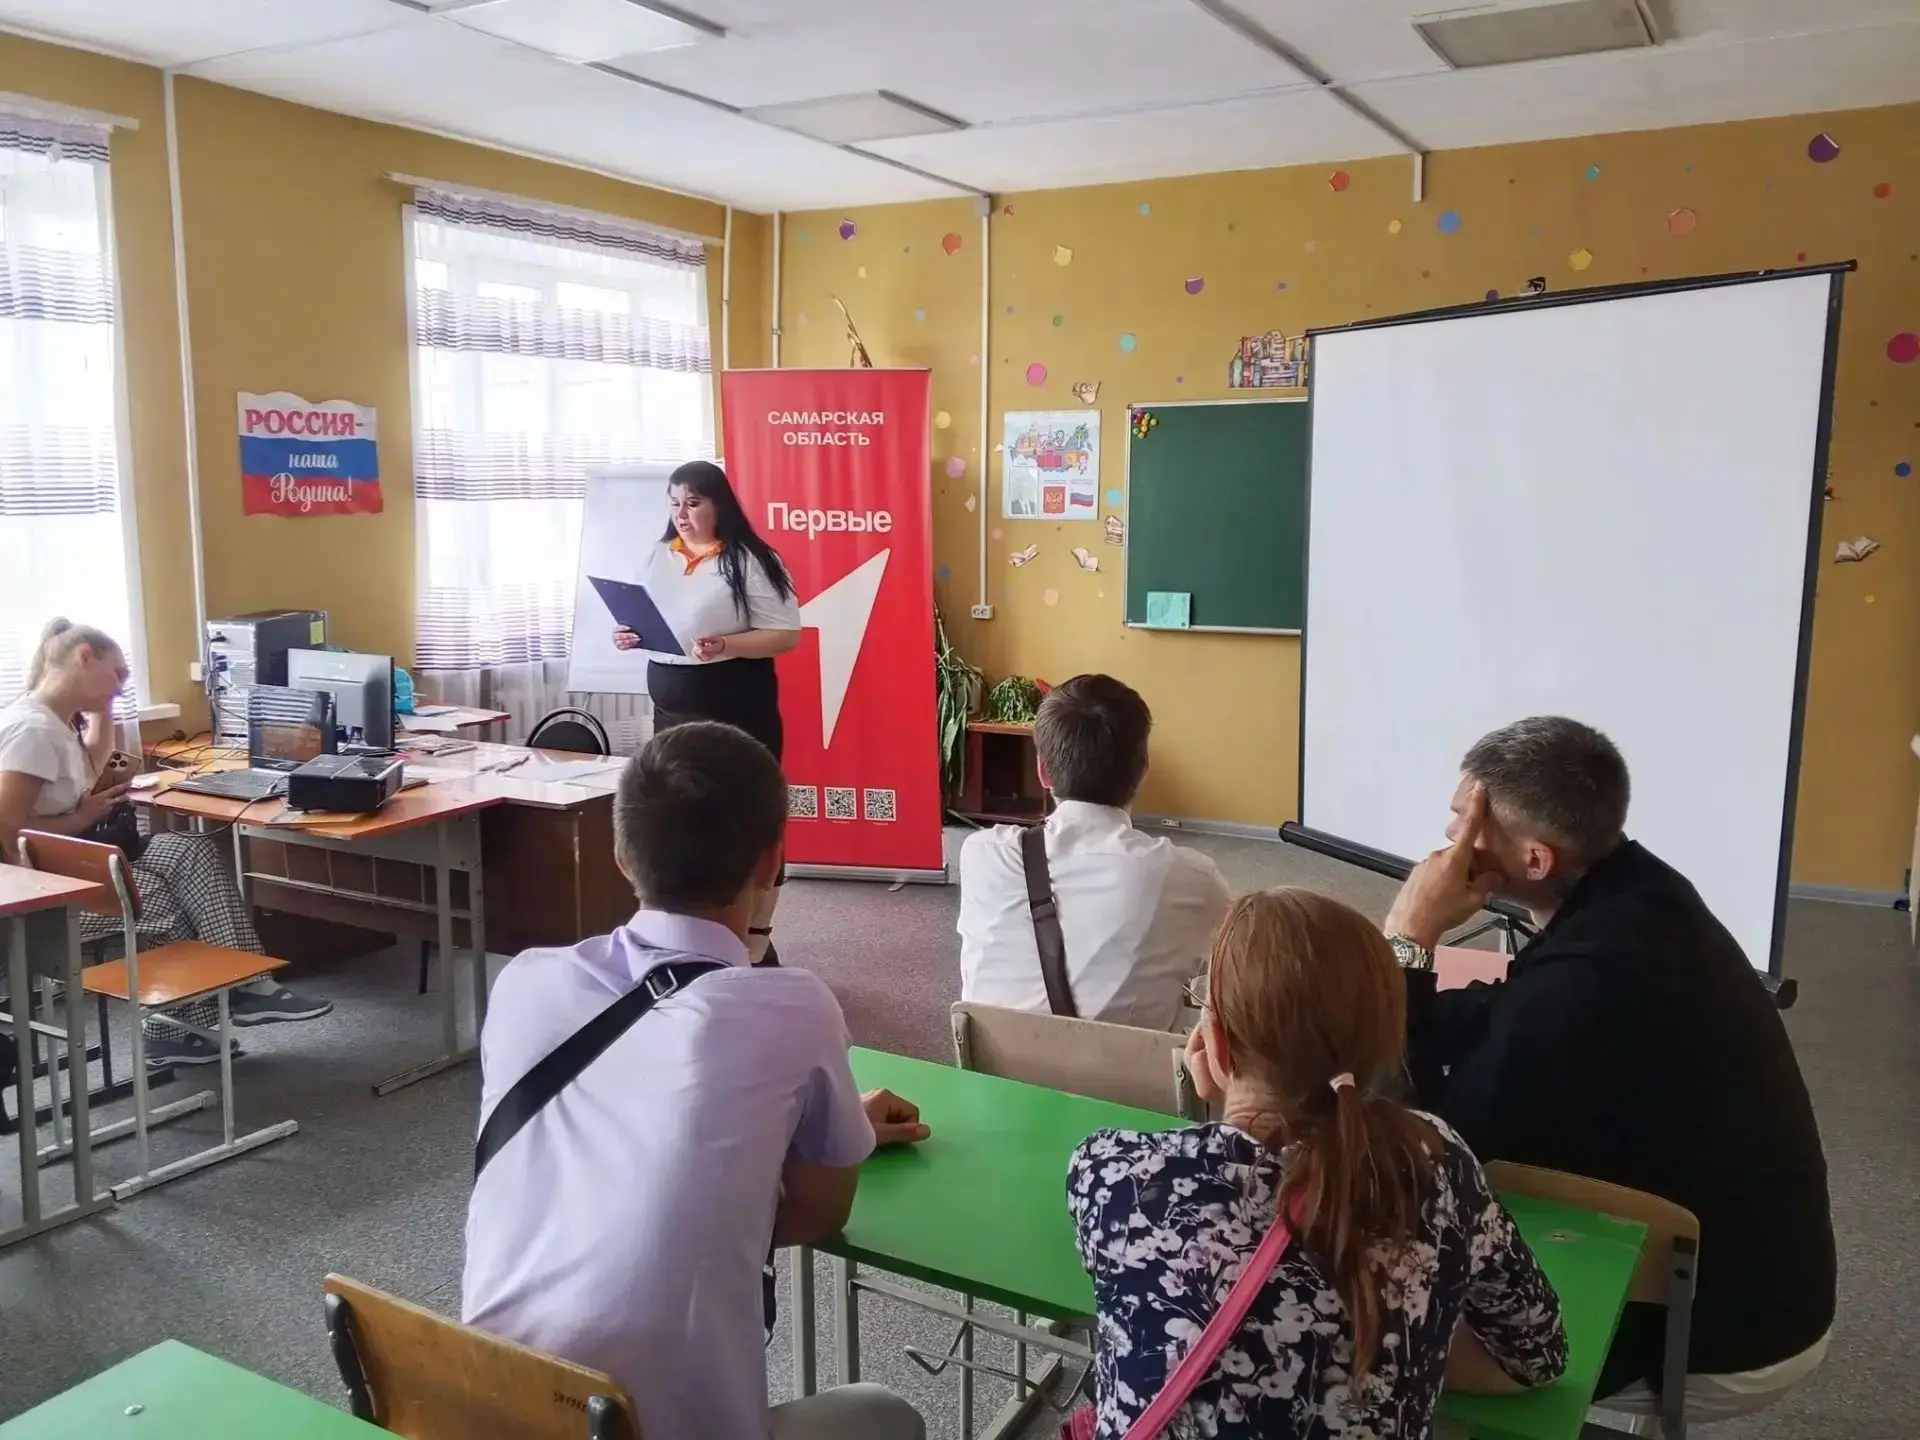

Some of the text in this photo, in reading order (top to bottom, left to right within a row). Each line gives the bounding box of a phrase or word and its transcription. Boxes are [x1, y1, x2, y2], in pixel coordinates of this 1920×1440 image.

[767, 411, 884, 425] САМАРСКАЯ
[783, 431, 870, 446] ОБЛАСТЬ
[288, 453, 339, 469] наша
[270, 472, 353, 513] Родина!
[767, 502, 893, 541] Первые
